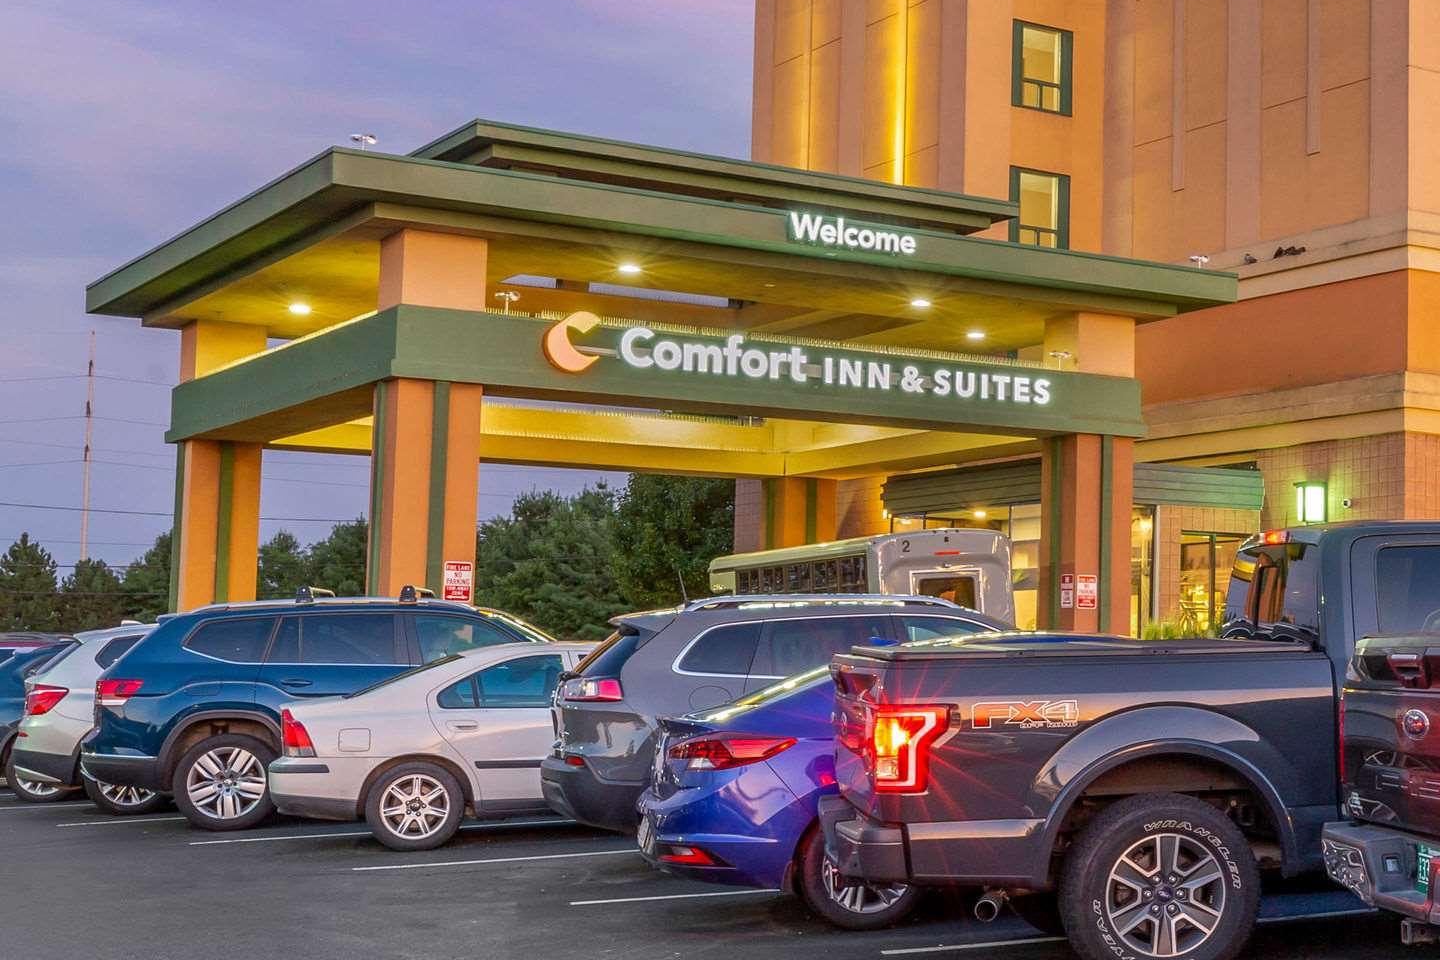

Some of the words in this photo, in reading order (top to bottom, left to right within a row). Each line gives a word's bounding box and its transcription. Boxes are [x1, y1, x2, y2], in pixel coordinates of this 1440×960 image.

[789, 211, 917, 254] Welcome
[620, 326, 808, 383] Comfort
[823, 357, 891, 390] INN
[901, 365, 925, 394] &
[933, 369, 1052, 405] SUITES
[902, 540, 911, 553] 2
[972, 700, 1079, 729] FX4
[1143, 819, 1242, 889] WRANGLER
